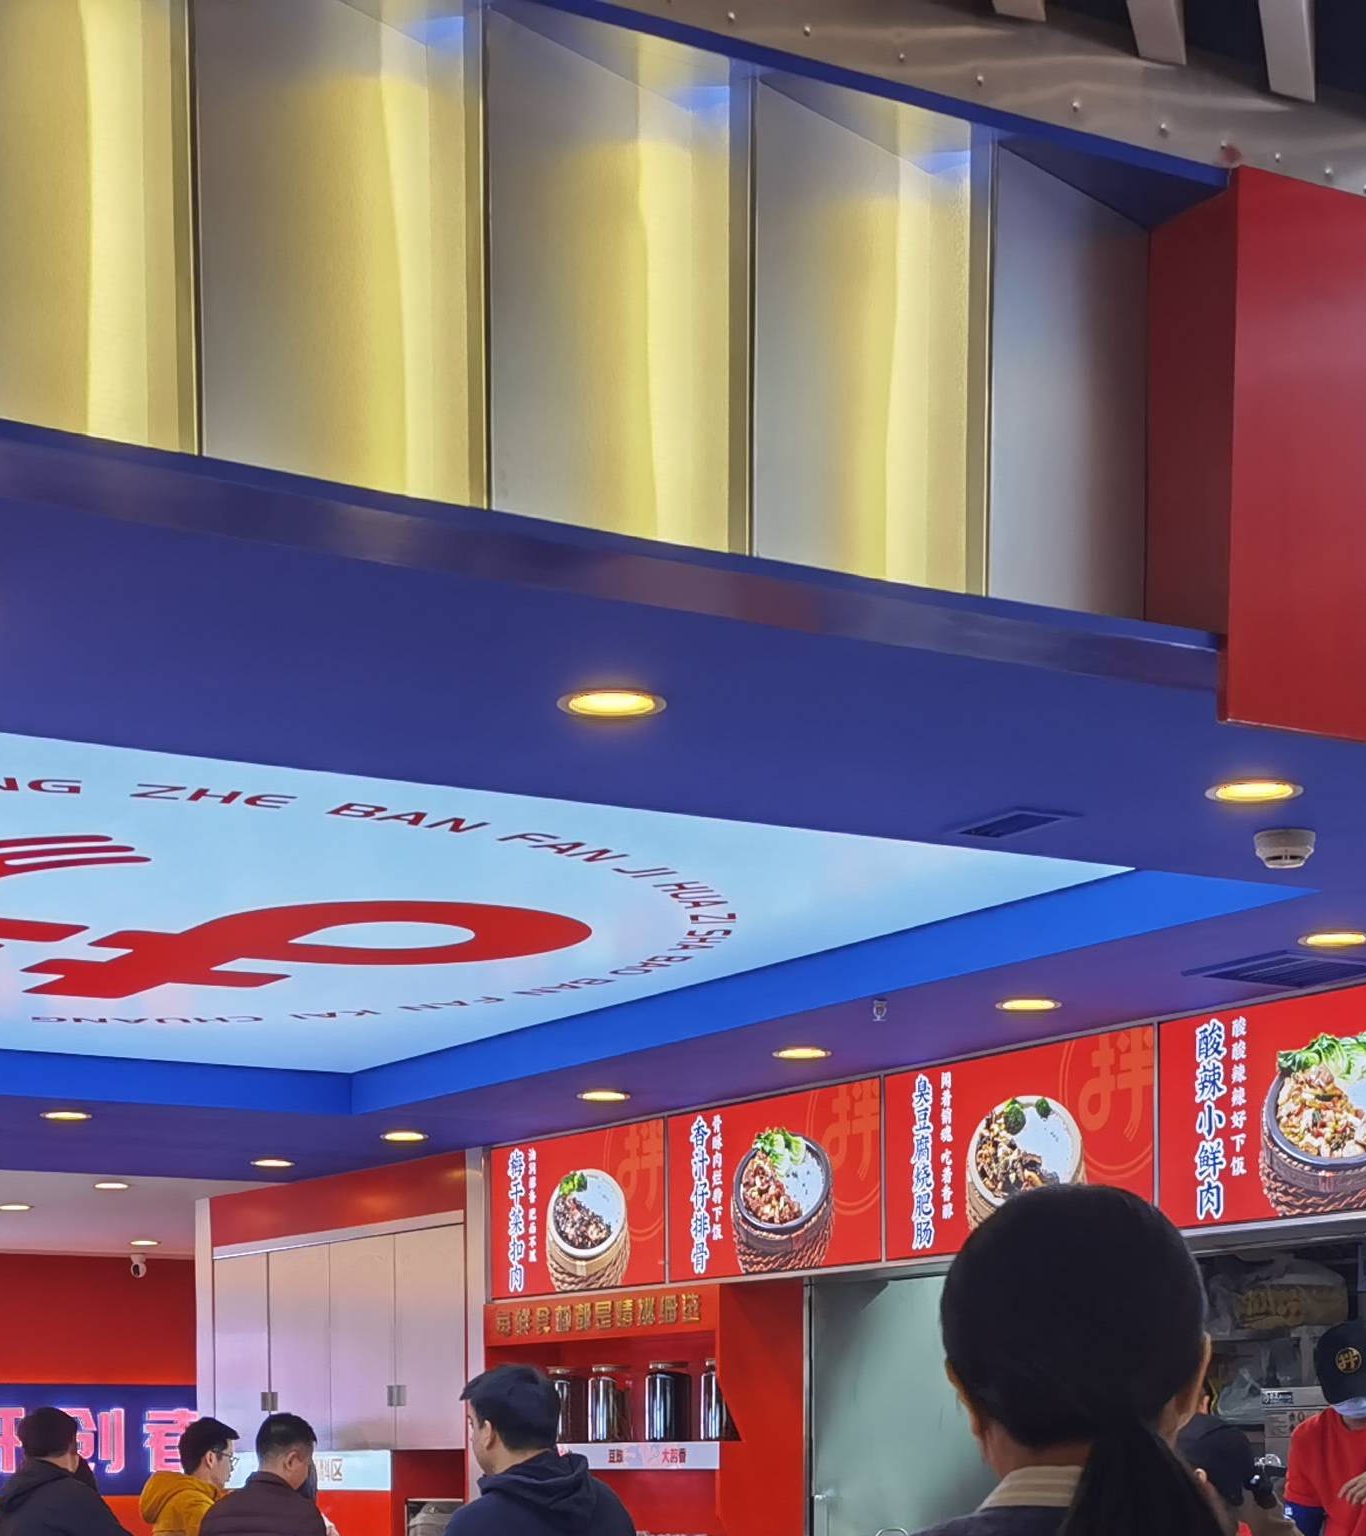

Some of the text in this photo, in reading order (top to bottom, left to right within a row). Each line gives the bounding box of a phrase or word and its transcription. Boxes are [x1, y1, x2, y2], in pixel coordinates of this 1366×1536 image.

[130, 784, 297, 809] ZHE
[326, 803, 491, 833] BAN
[496, 833, 630, 862] FAN
[653, 881, 728, 909] HUA
[690, 1115, 711, 1274] 香汁仔排骨
[911, 1074, 934, 1249] 臭豆腐烧肥肠
[1195, 1018, 1224, 1221] 酸辣小鲜肉
[508, 1148, 525, 1292] 梅干菜扣肉
